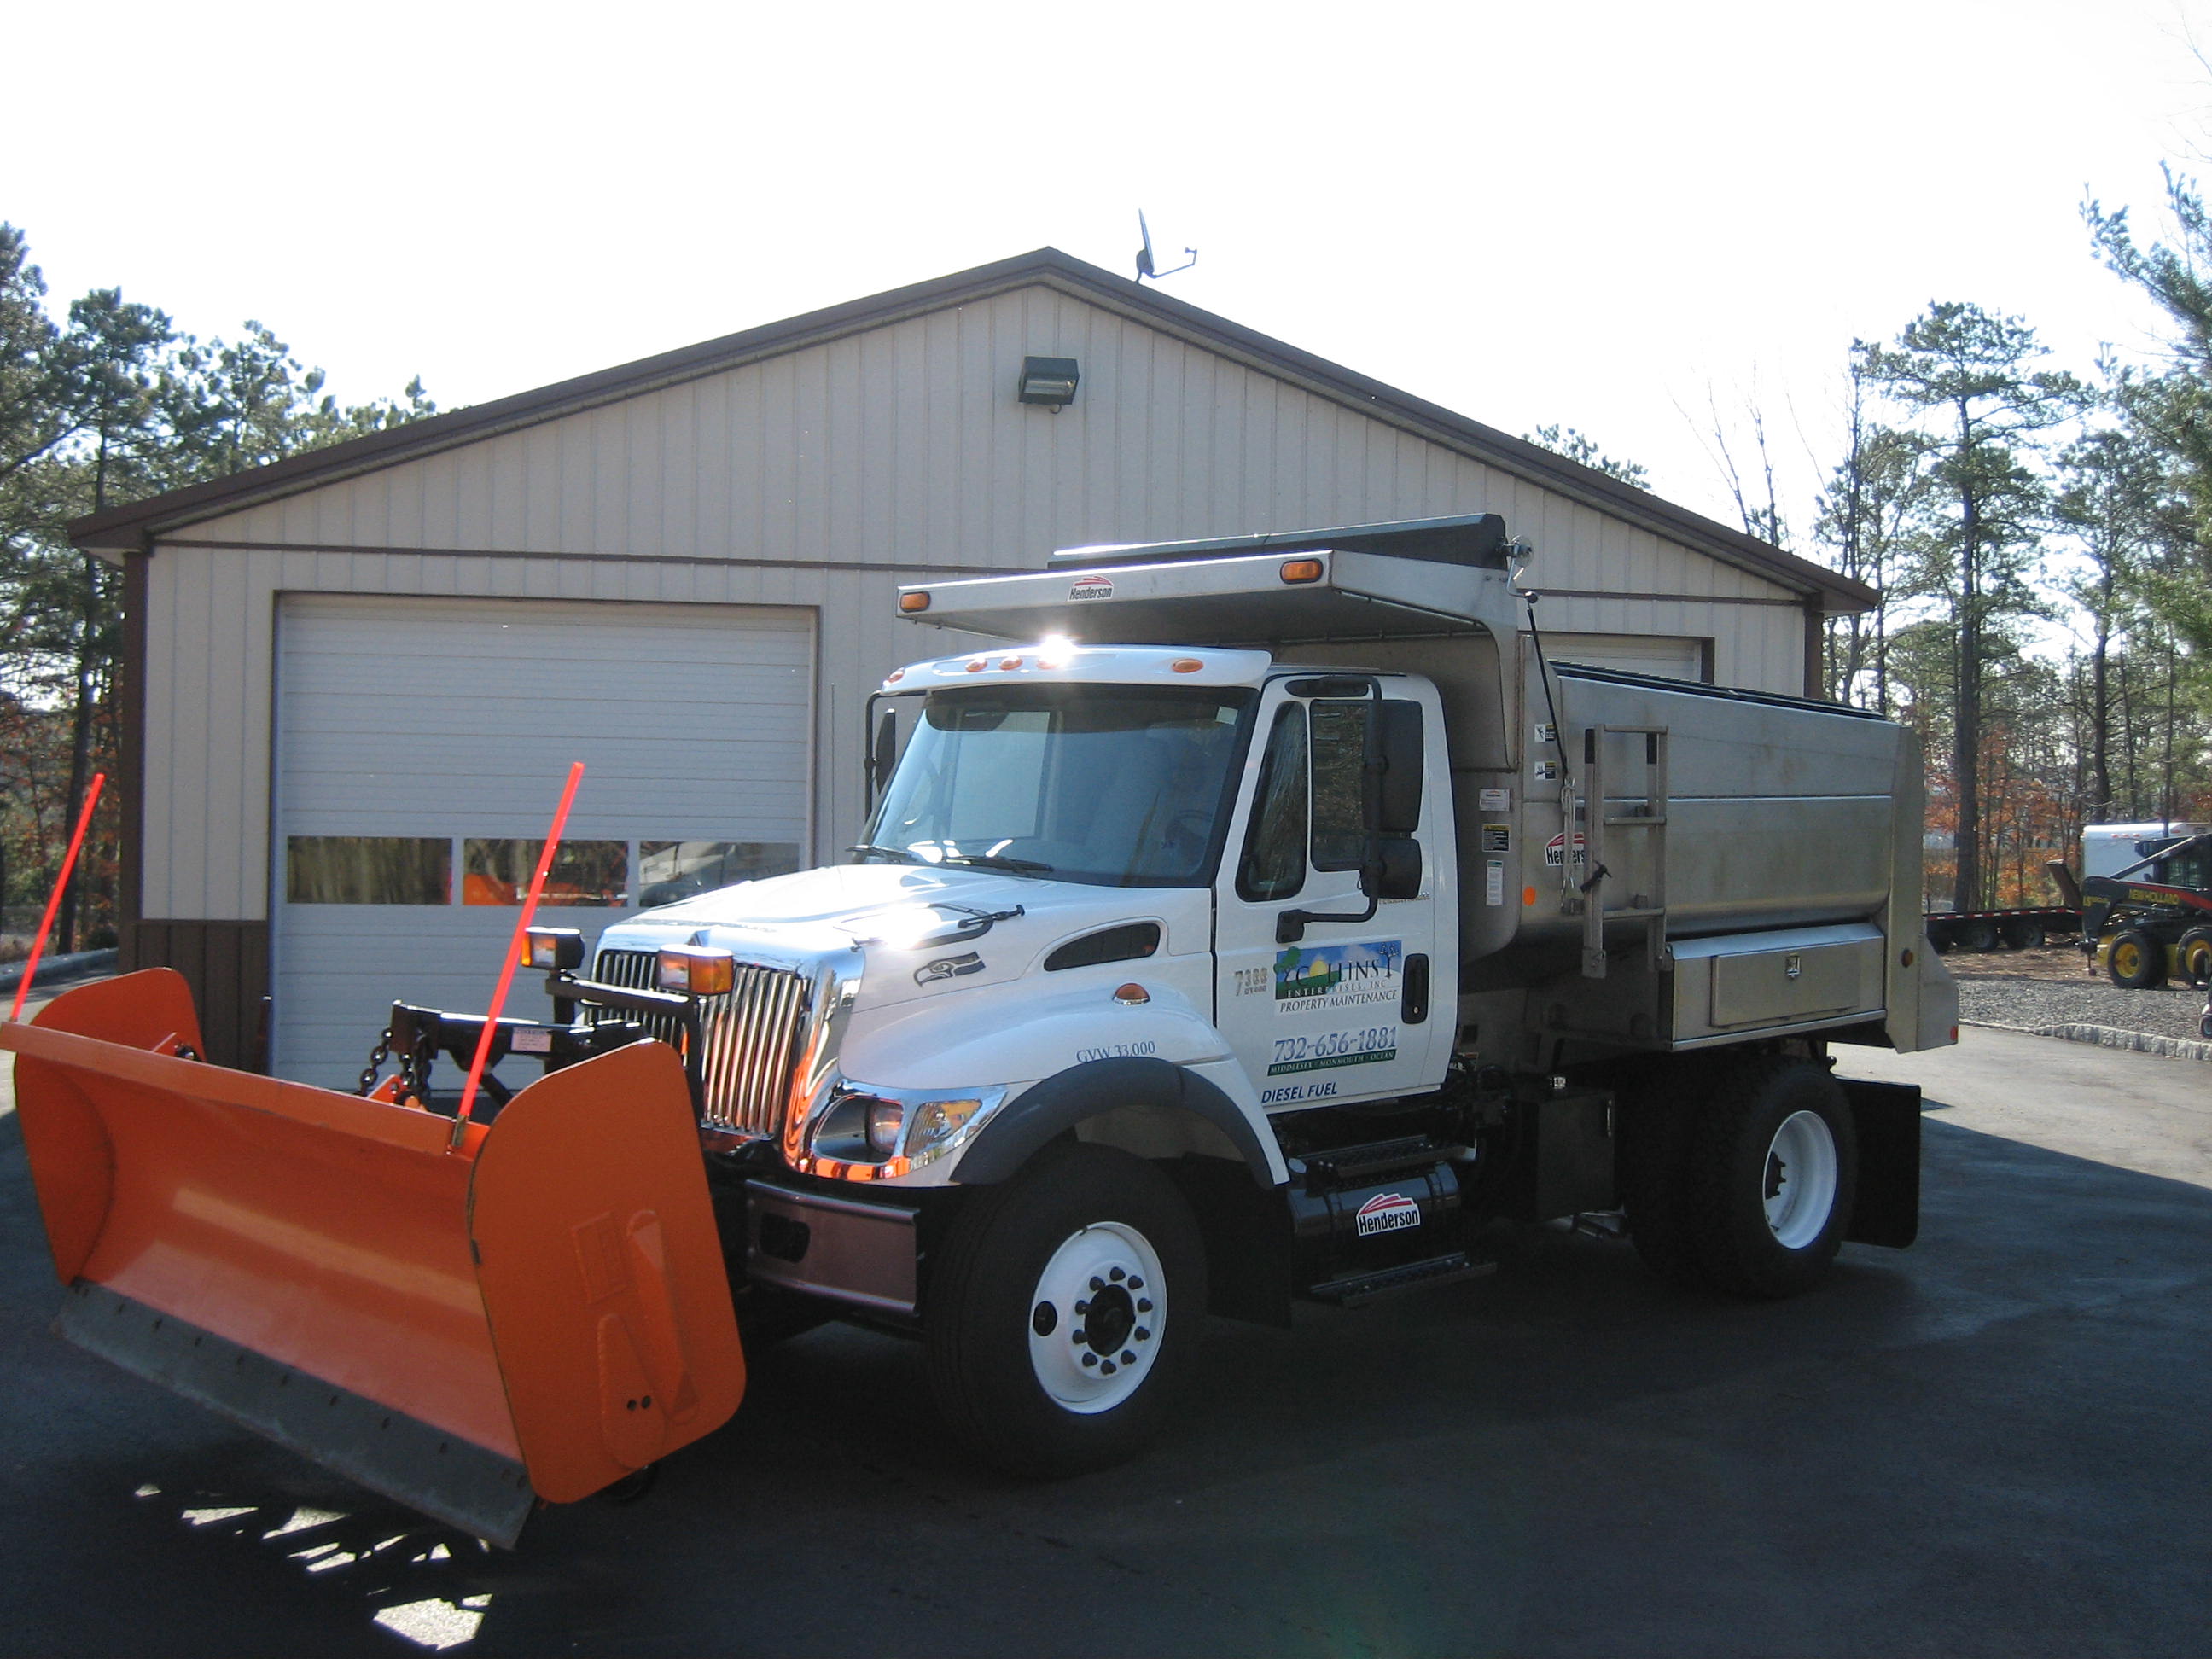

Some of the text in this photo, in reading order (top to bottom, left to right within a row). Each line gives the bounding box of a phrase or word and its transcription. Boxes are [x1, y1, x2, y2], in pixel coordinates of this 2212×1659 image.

[1069, 587, 1113, 600] Henderson
[1280, 990, 1398, 1013] PROPERTY MAINTENANCE
[1076, 1046, 1110, 1064] GVW
[1274, 1027, 1398, 1063] 732-656-1881
[1270, 1051, 1394, 1074] MIDDLESEX MONMOUTH OCEAN
[1261, 1082, 1338, 1103] DIESEL FUEL
[1359, 1210, 1419, 1234] Henderson
